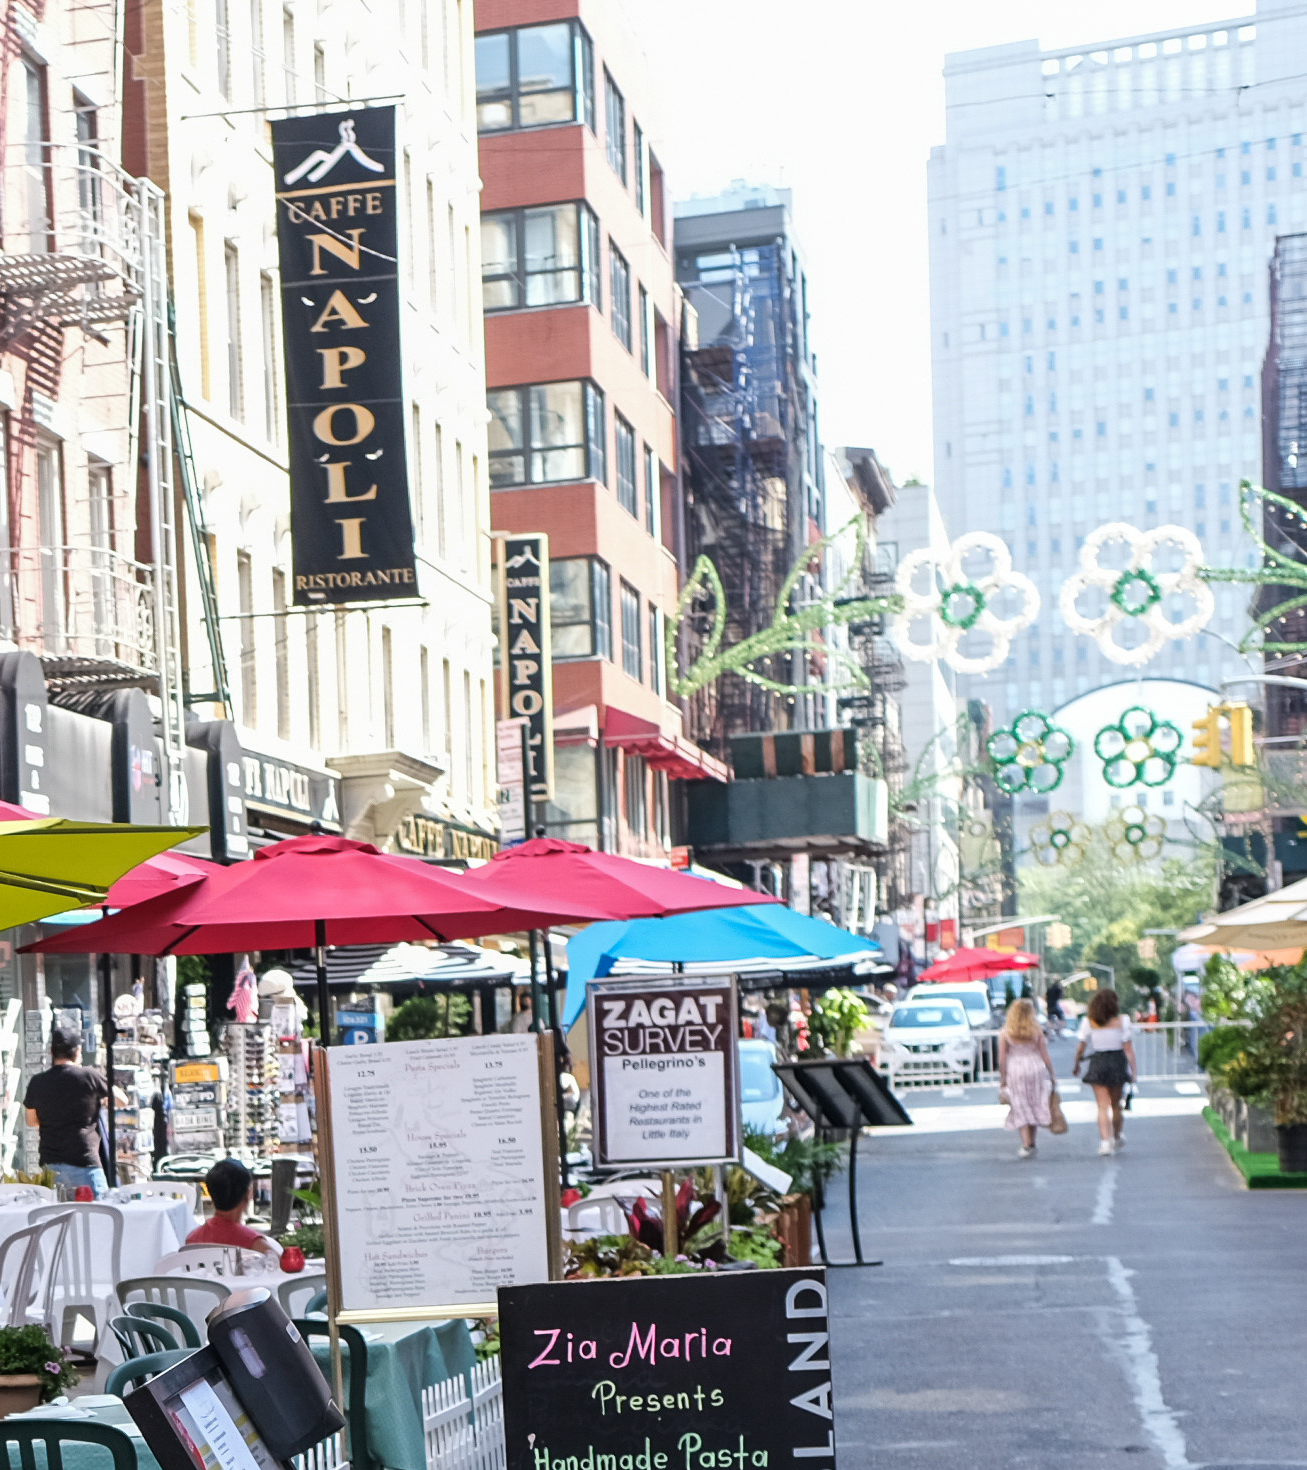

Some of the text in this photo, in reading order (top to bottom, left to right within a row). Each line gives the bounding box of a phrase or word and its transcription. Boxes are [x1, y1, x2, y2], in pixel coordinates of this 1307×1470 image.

[288, 193, 384, 224] CAFFE
[305, 227, 377, 561] NAPOLI
[295, 566, 415, 591] RISTORANTE
[602, 995, 724, 1029] ZAGAT
[603, 1024, 724, 1055] SURVEY
[622, 1055, 706, 1072] Pellegrino's
[629, 1101, 702, 1115] Highest Rated
[638, 1088, 692, 1099] One of the
[629, 1114, 703, 1127] Restaurants in
[642, 1129, 691, 1142] Little Italy
[527, 1321, 733, 1369] Zia Maria
[591, 1379, 725, 1416] Presents
[677, 1431, 769, 1470] Pasta
